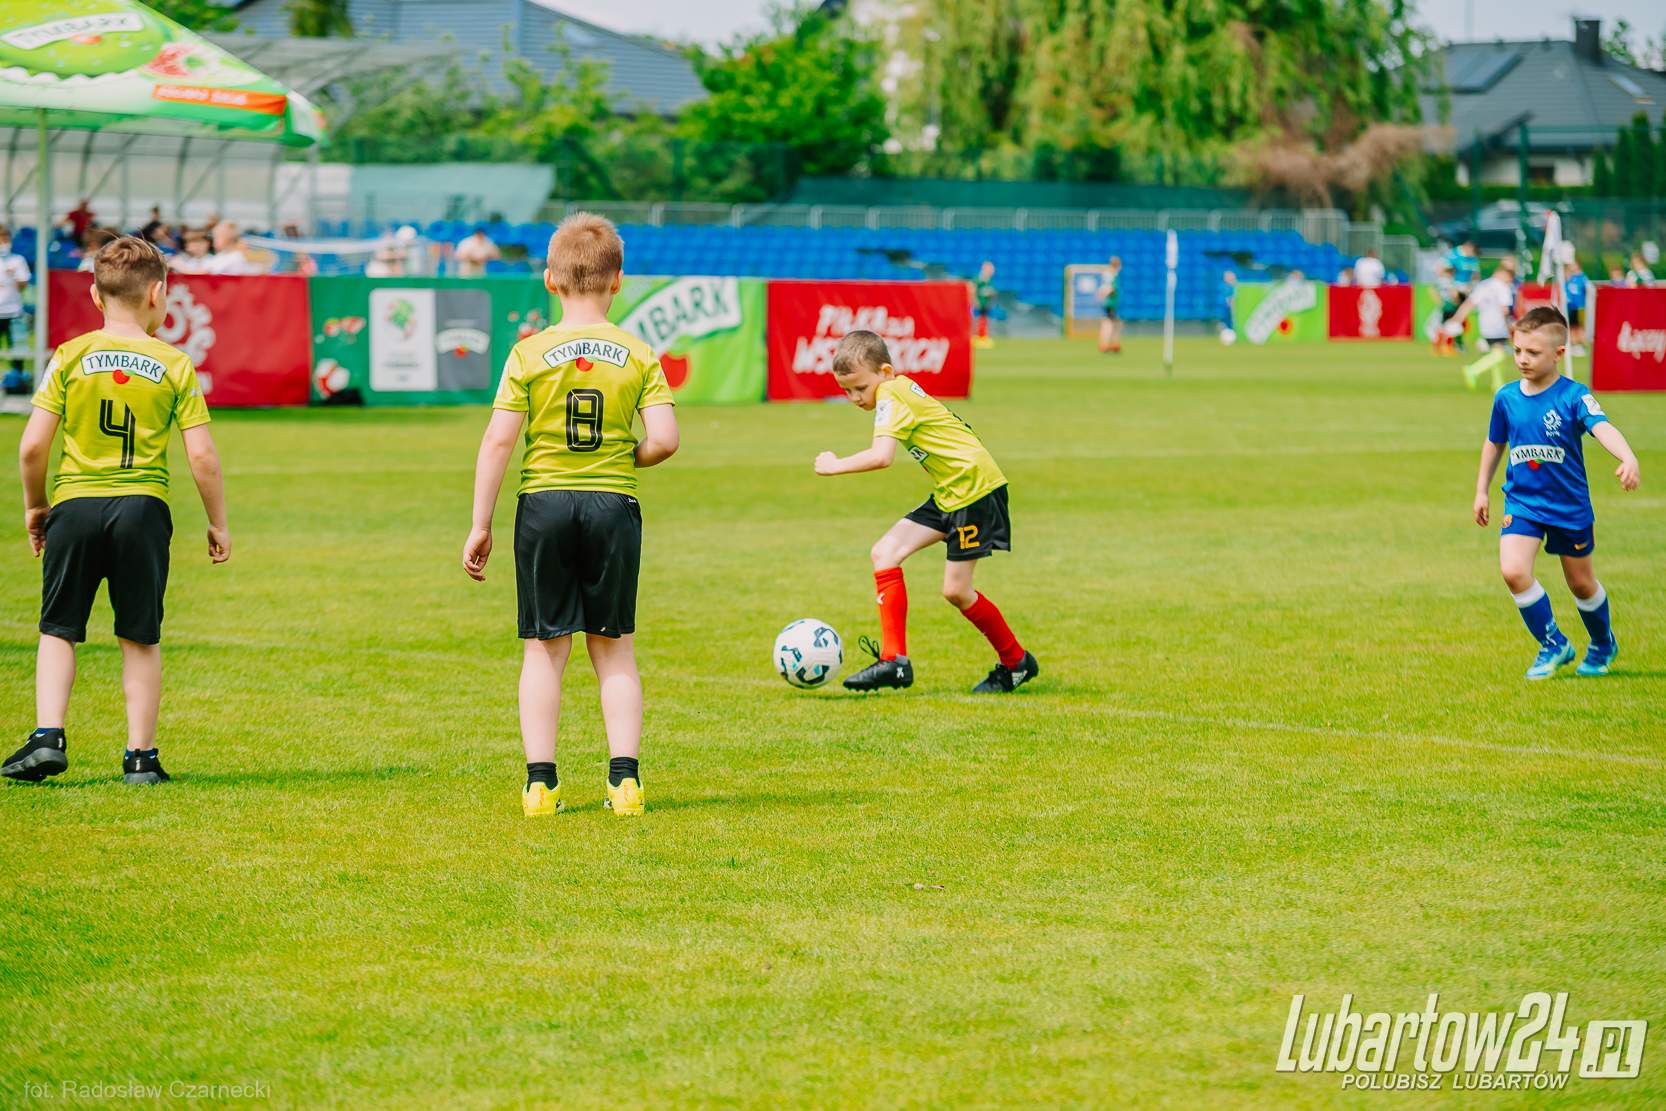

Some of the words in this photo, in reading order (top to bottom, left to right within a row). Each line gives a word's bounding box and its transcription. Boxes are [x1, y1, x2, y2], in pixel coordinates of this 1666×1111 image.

[549, 342, 623, 362] TYMBARK
[86, 354, 161, 378] TYMBARK
[566, 389, 604, 452] 8
[99, 398, 136, 469] 4
[957, 525, 980, 549] 12
